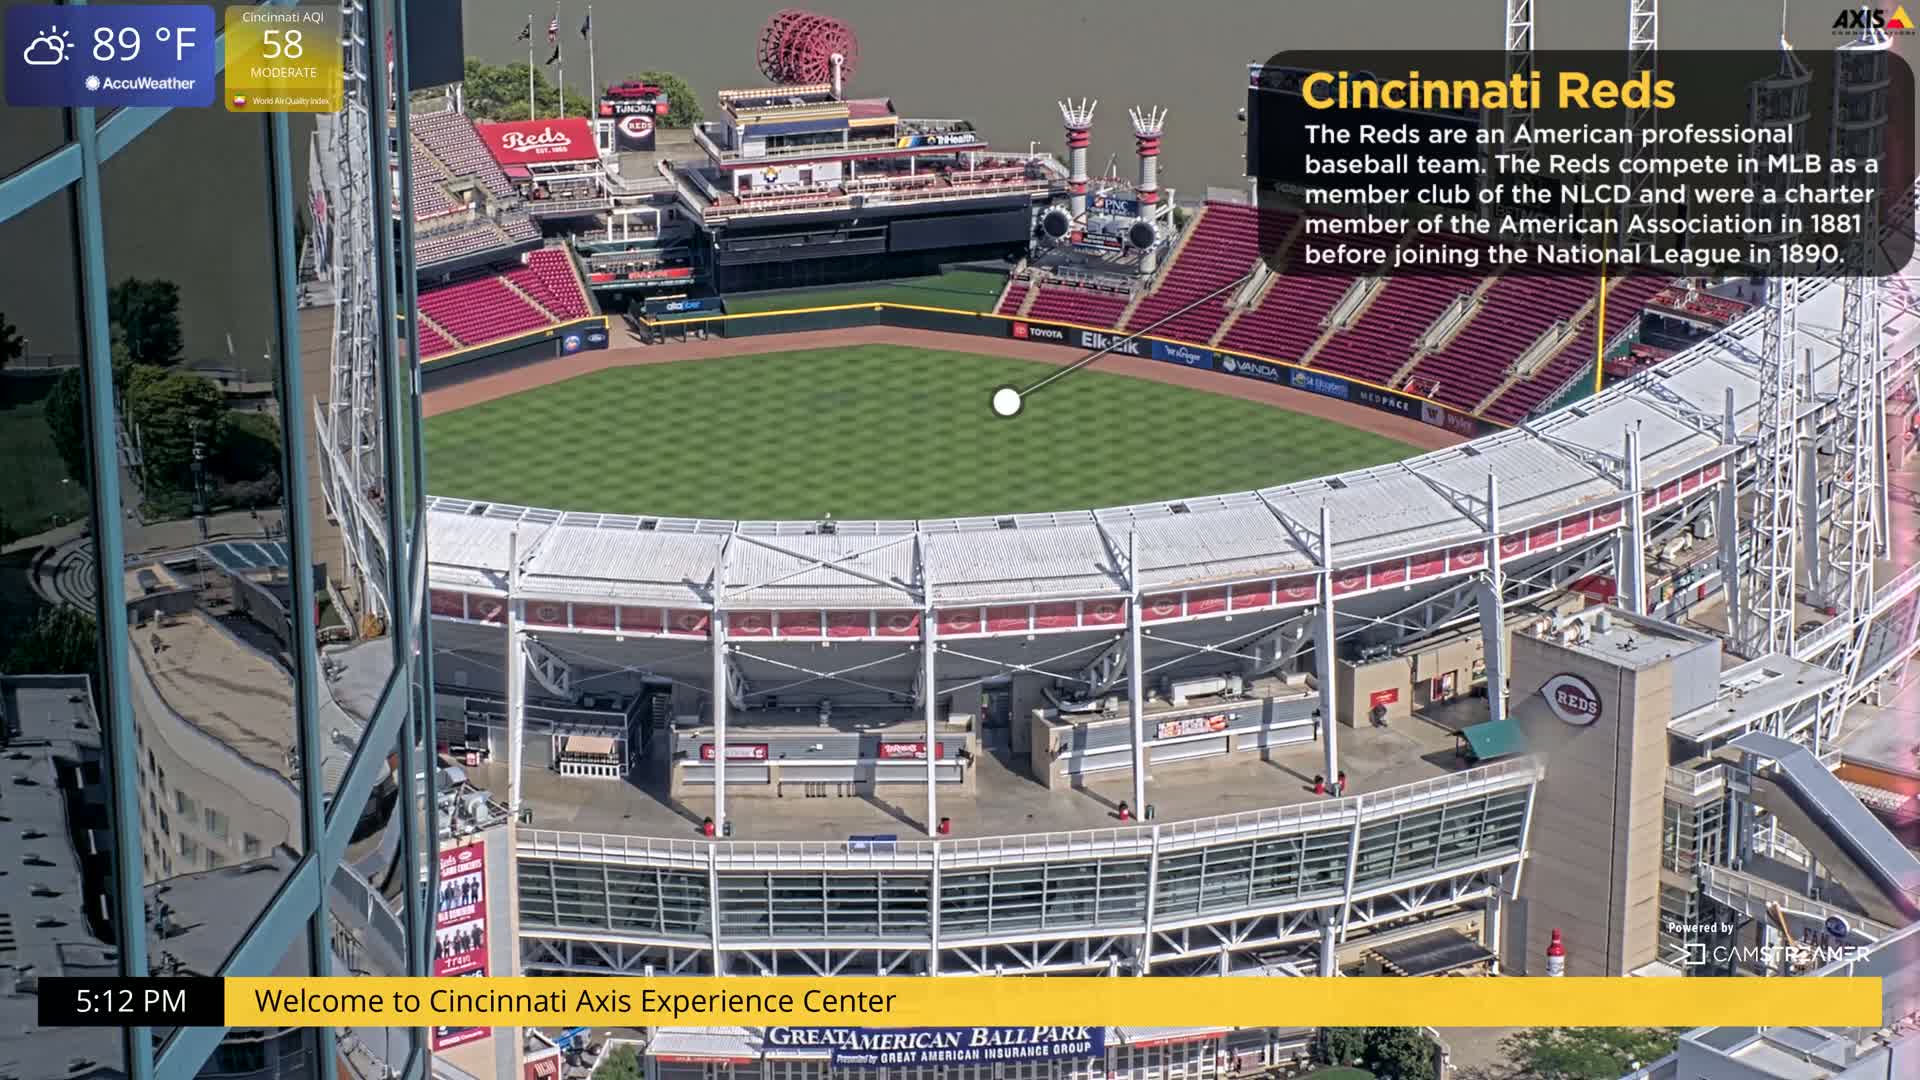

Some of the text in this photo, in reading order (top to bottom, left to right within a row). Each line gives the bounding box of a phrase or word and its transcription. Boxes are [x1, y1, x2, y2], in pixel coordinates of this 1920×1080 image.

[615, 104, 653, 113] TUNDRA
[628, 121, 654, 131] REDS
[502, 127, 572, 151] Reds
[936, 133, 975, 145] TriHealth
[1104, 199, 1129, 212] PNC
[1030, 328, 1063, 340] TOYOTA
[1236, 361, 1279, 377] VANDA
[1360, 391, 1409, 411] MEDPACE
[1557, 690, 1598, 714] REDS
[769, 1025, 1091, 1051] GREAT AMERICAN BALL PARK
[836, 1041, 1092, 1065] Presented by GREAT AMERICAN INSURANCE GROUP
